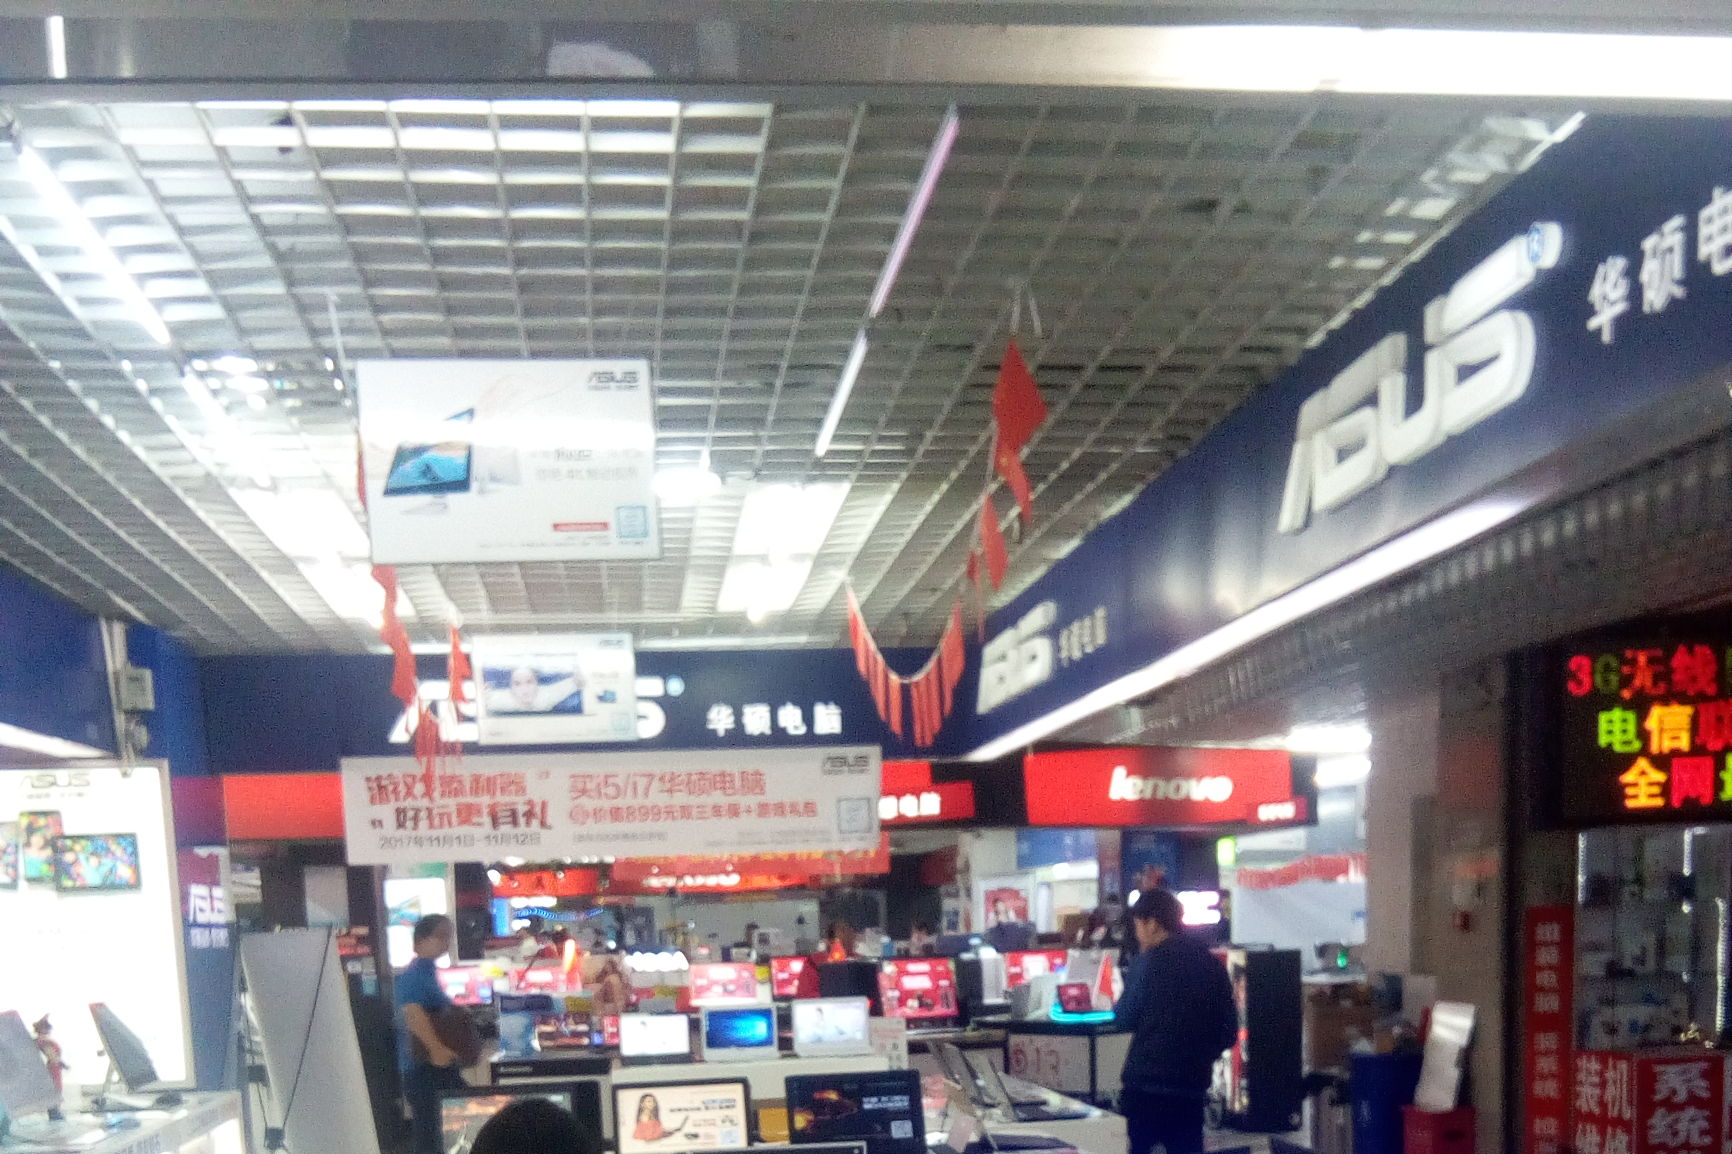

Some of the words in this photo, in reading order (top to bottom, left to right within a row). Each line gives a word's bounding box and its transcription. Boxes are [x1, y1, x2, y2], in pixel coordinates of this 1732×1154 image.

[1279, 221, 1563, 534] ASUS
[706, 701, 843, 737] 华硕电脑
[1109, 765, 1233, 801] lenovo
